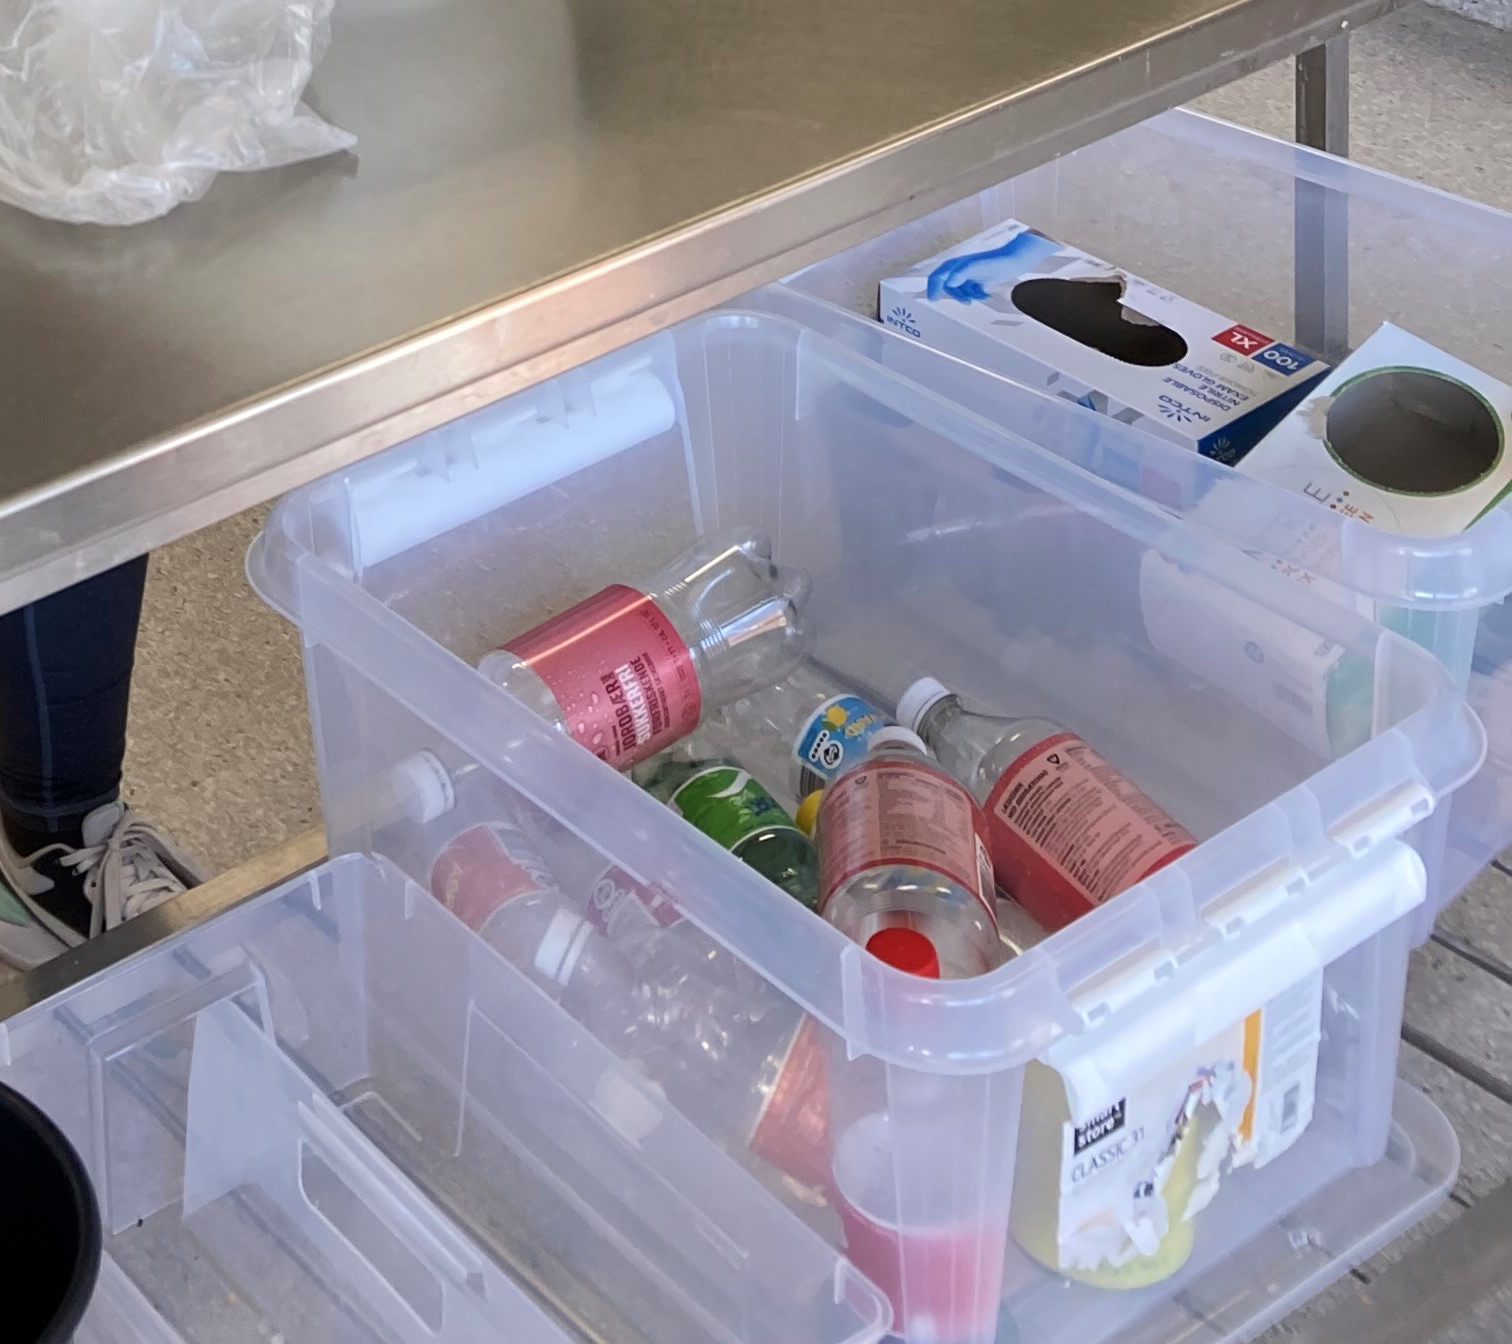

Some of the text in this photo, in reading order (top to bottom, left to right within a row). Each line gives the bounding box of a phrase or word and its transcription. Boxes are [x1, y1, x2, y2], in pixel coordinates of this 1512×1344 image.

[887, 315, 921, 338] INTCO
[1229, 331, 1258, 349] XL
[1263, 349, 1300, 372] 100
[1161, 377, 1231, 412] DISPOSABLE
[1172, 363, 1250, 402] EXAM GLOVES
[1157, 394, 1211, 423] INTCO
[1071, 1137, 1128, 1183] CLASSIC
